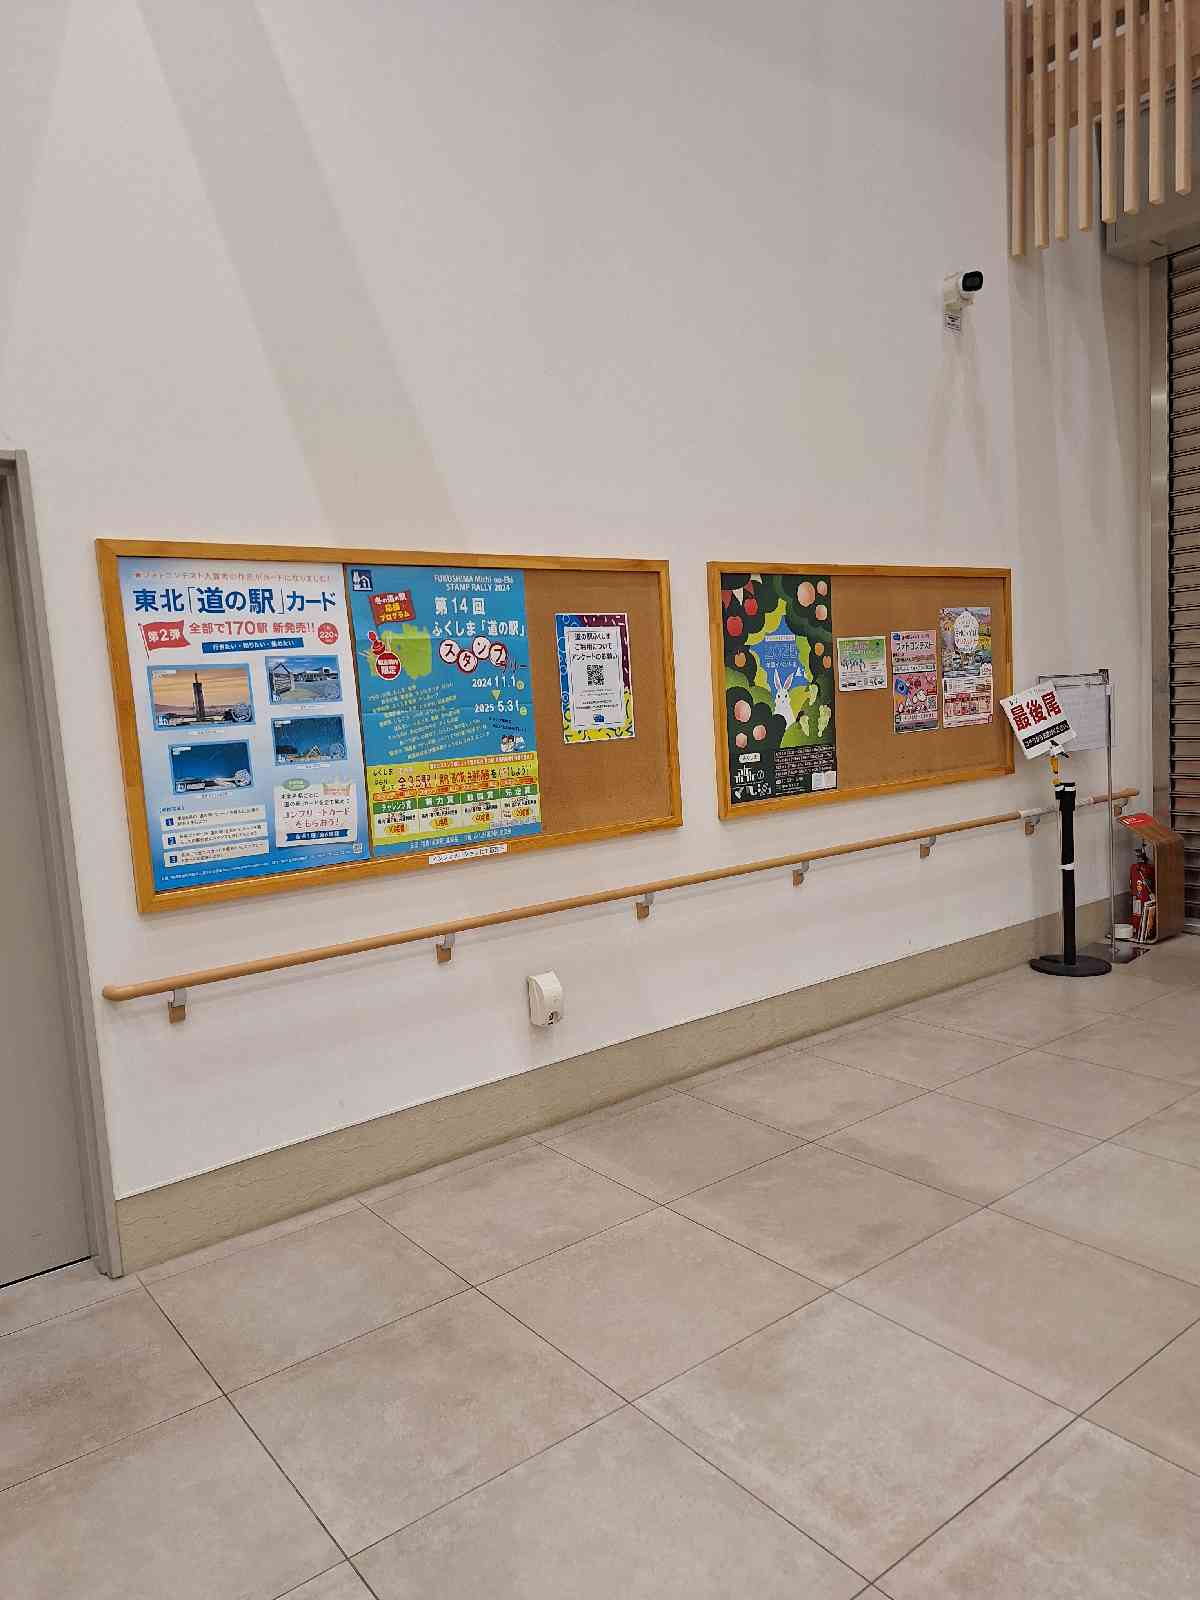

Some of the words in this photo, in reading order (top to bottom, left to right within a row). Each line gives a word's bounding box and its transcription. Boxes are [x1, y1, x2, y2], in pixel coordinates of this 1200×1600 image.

[132, 586, 336, 615] 東北「道の駅」カード
[147, 628, 180, 642] 第2弾
[189, 620, 267, 635] 全部で170駅
[1010, 691, 1062, 732] 最後尾
